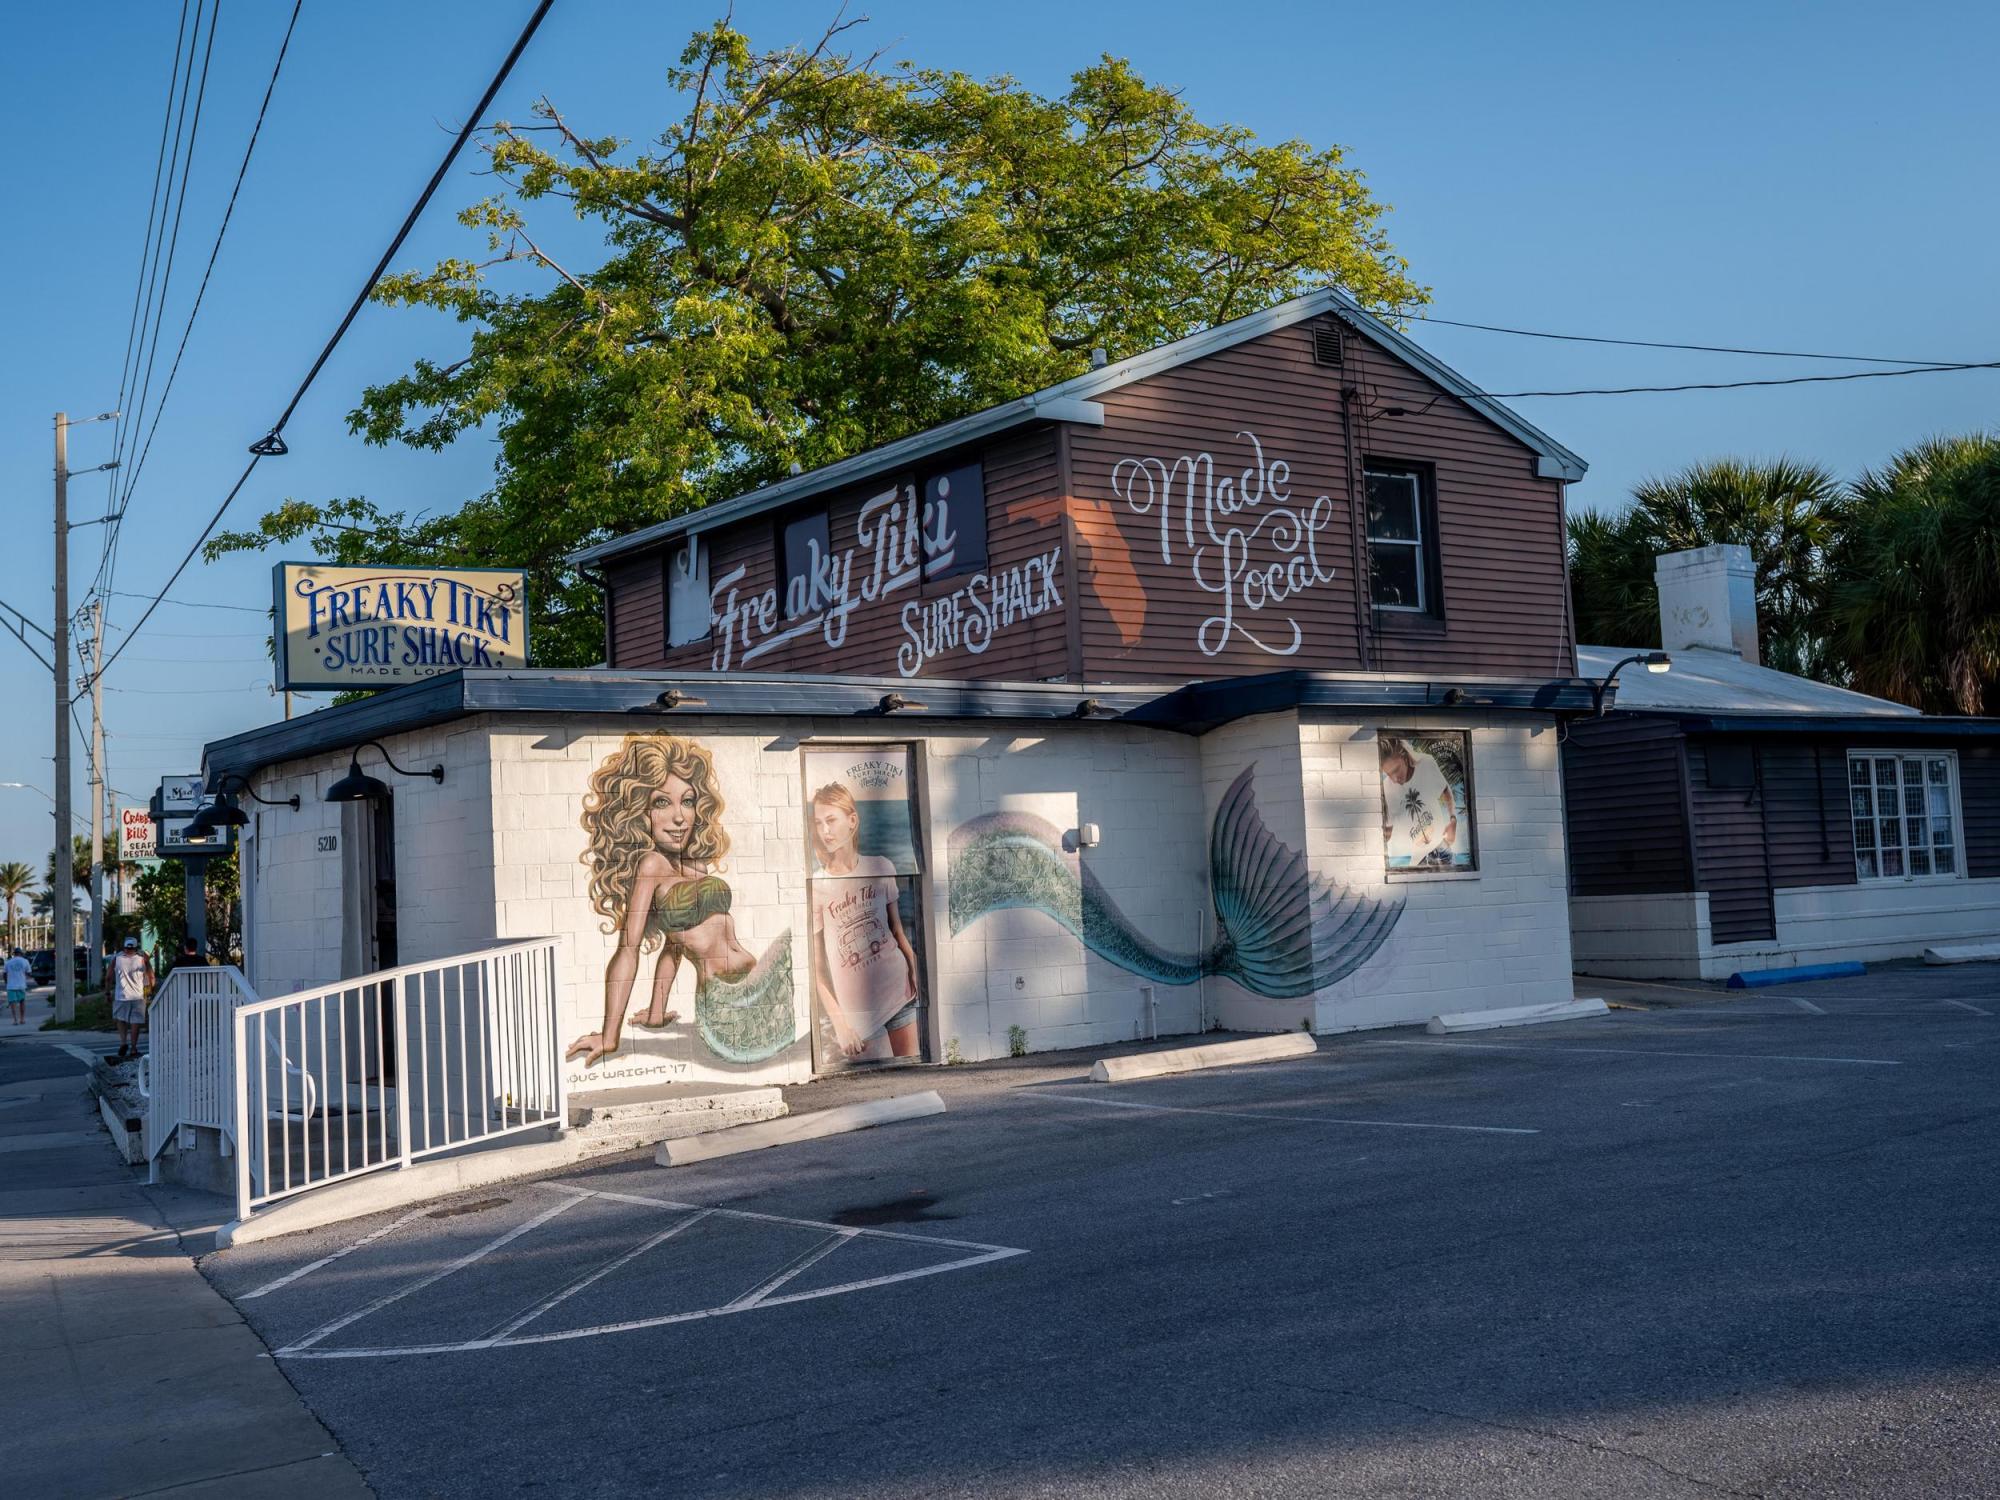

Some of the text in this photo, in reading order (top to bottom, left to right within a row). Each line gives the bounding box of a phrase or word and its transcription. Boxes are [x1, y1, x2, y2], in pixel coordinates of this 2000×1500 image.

[1112, 431, 1291, 565] Made
[711, 484, 956, 672] Freaky Tiki
[1193, 496, 1335, 656] Local
[296, 577, 512, 646] FREAKY TIKI
[897, 545, 1064, 677] SURF SHACK
[323, 624, 492, 671] SURF SHACK
[350, 667, 401, 677] MADE
[846, 761, 903, 777] FREAKY TIKI
[123, 810, 153, 825] CRABB
[318, 836, 337, 852] 5210
[828, 890, 857, 919] Freaky
[860, 884, 877, 901] Tiki
[567, 1072, 599, 1084] OUG
[603, 1065, 666, 1079] WRIGHT
